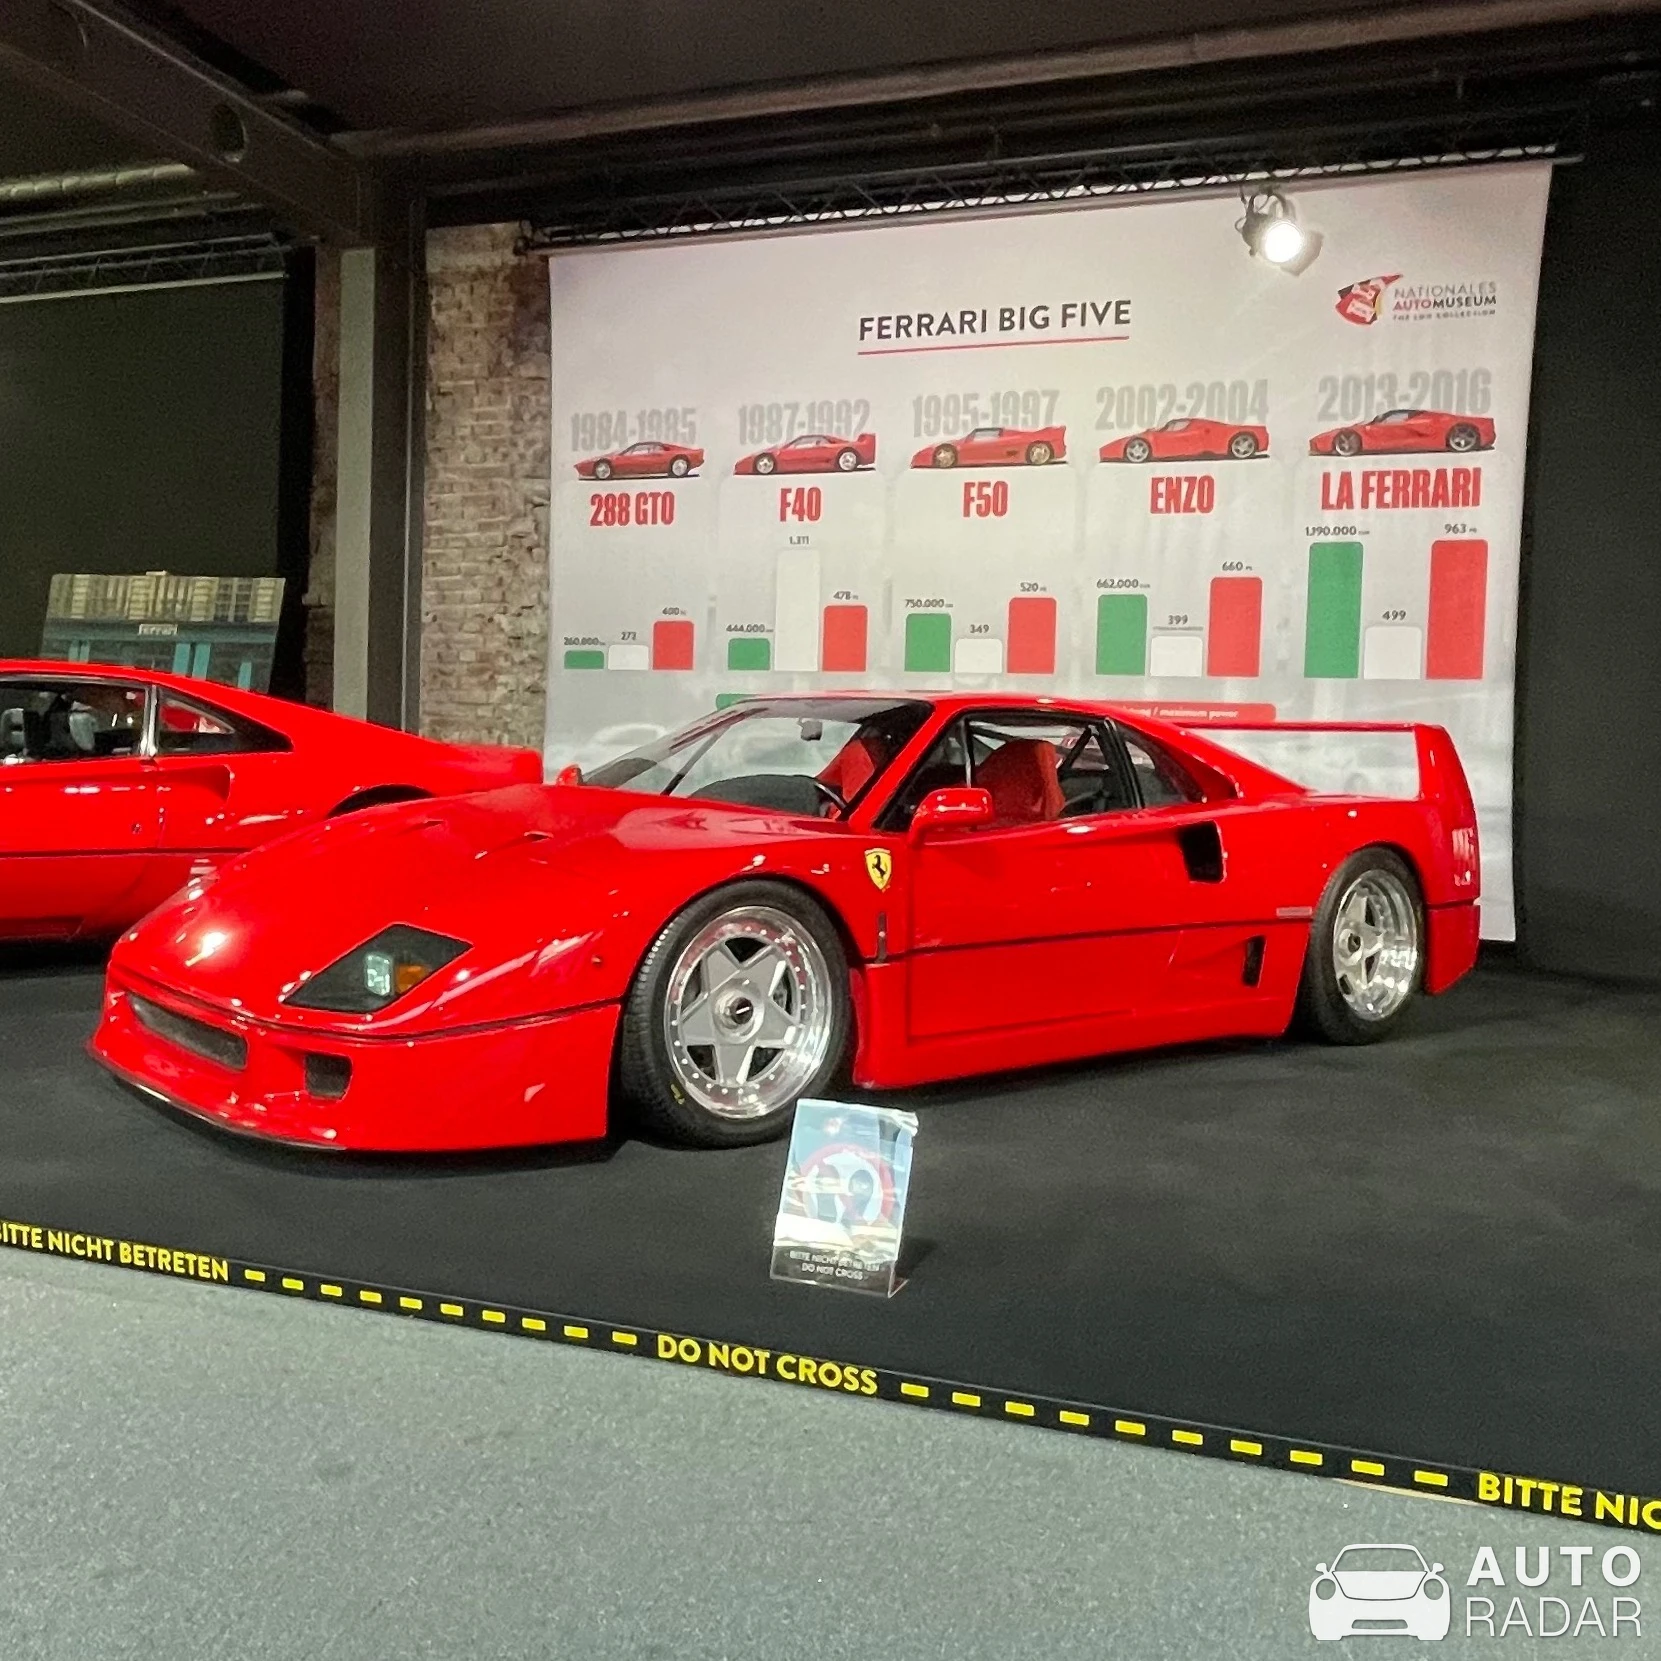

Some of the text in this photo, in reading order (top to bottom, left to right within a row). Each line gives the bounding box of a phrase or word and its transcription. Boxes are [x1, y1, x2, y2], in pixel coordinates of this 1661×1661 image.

[1392, 295, 1496, 311] AUTOMUSEUM
[1394, 282, 1496, 298] NATIONALES
[859, 299, 1131, 341] FERRARI BIG FIVE
[1095, 379, 1268, 430] 2002-2004
[1318, 367, 1492, 422] 2013-2016
[570, 408, 696, 451] 1984-1985
[738, 398, 870, 445] 1987-1992
[912, 389, 1060, 438] 1995-1997
[780, 486, 823, 522] F40
[963, 480, 1009, 518] F50
[1150, 475, 1216, 515] ENZO
[1321, 467, 1483, 511] LA FERRARI
[590, 491, 676, 527] 288 GTO
[1444, 523, 1467, 534] 963
[1096, 579, 1139, 589] 662.000
[1222, 561, 1243, 571] 660
[833, 591, 851, 600] 478
[905, 599, 945, 608] 750.000
[1020, 582, 1038, 592] 520
[726, 624, 765, 633] 444.000
[970, 624, 990, 634] 349
[1168, 614, 1189, 625] 399
[1382, 610, 1407, 621] 499
[0, 1222, 229, 1282] ITTE NICHT BETRETEN
[657, 1334, 878, 1396] DO NOT CROSS
[1478, 1471, 1583, 1517] BITTE
